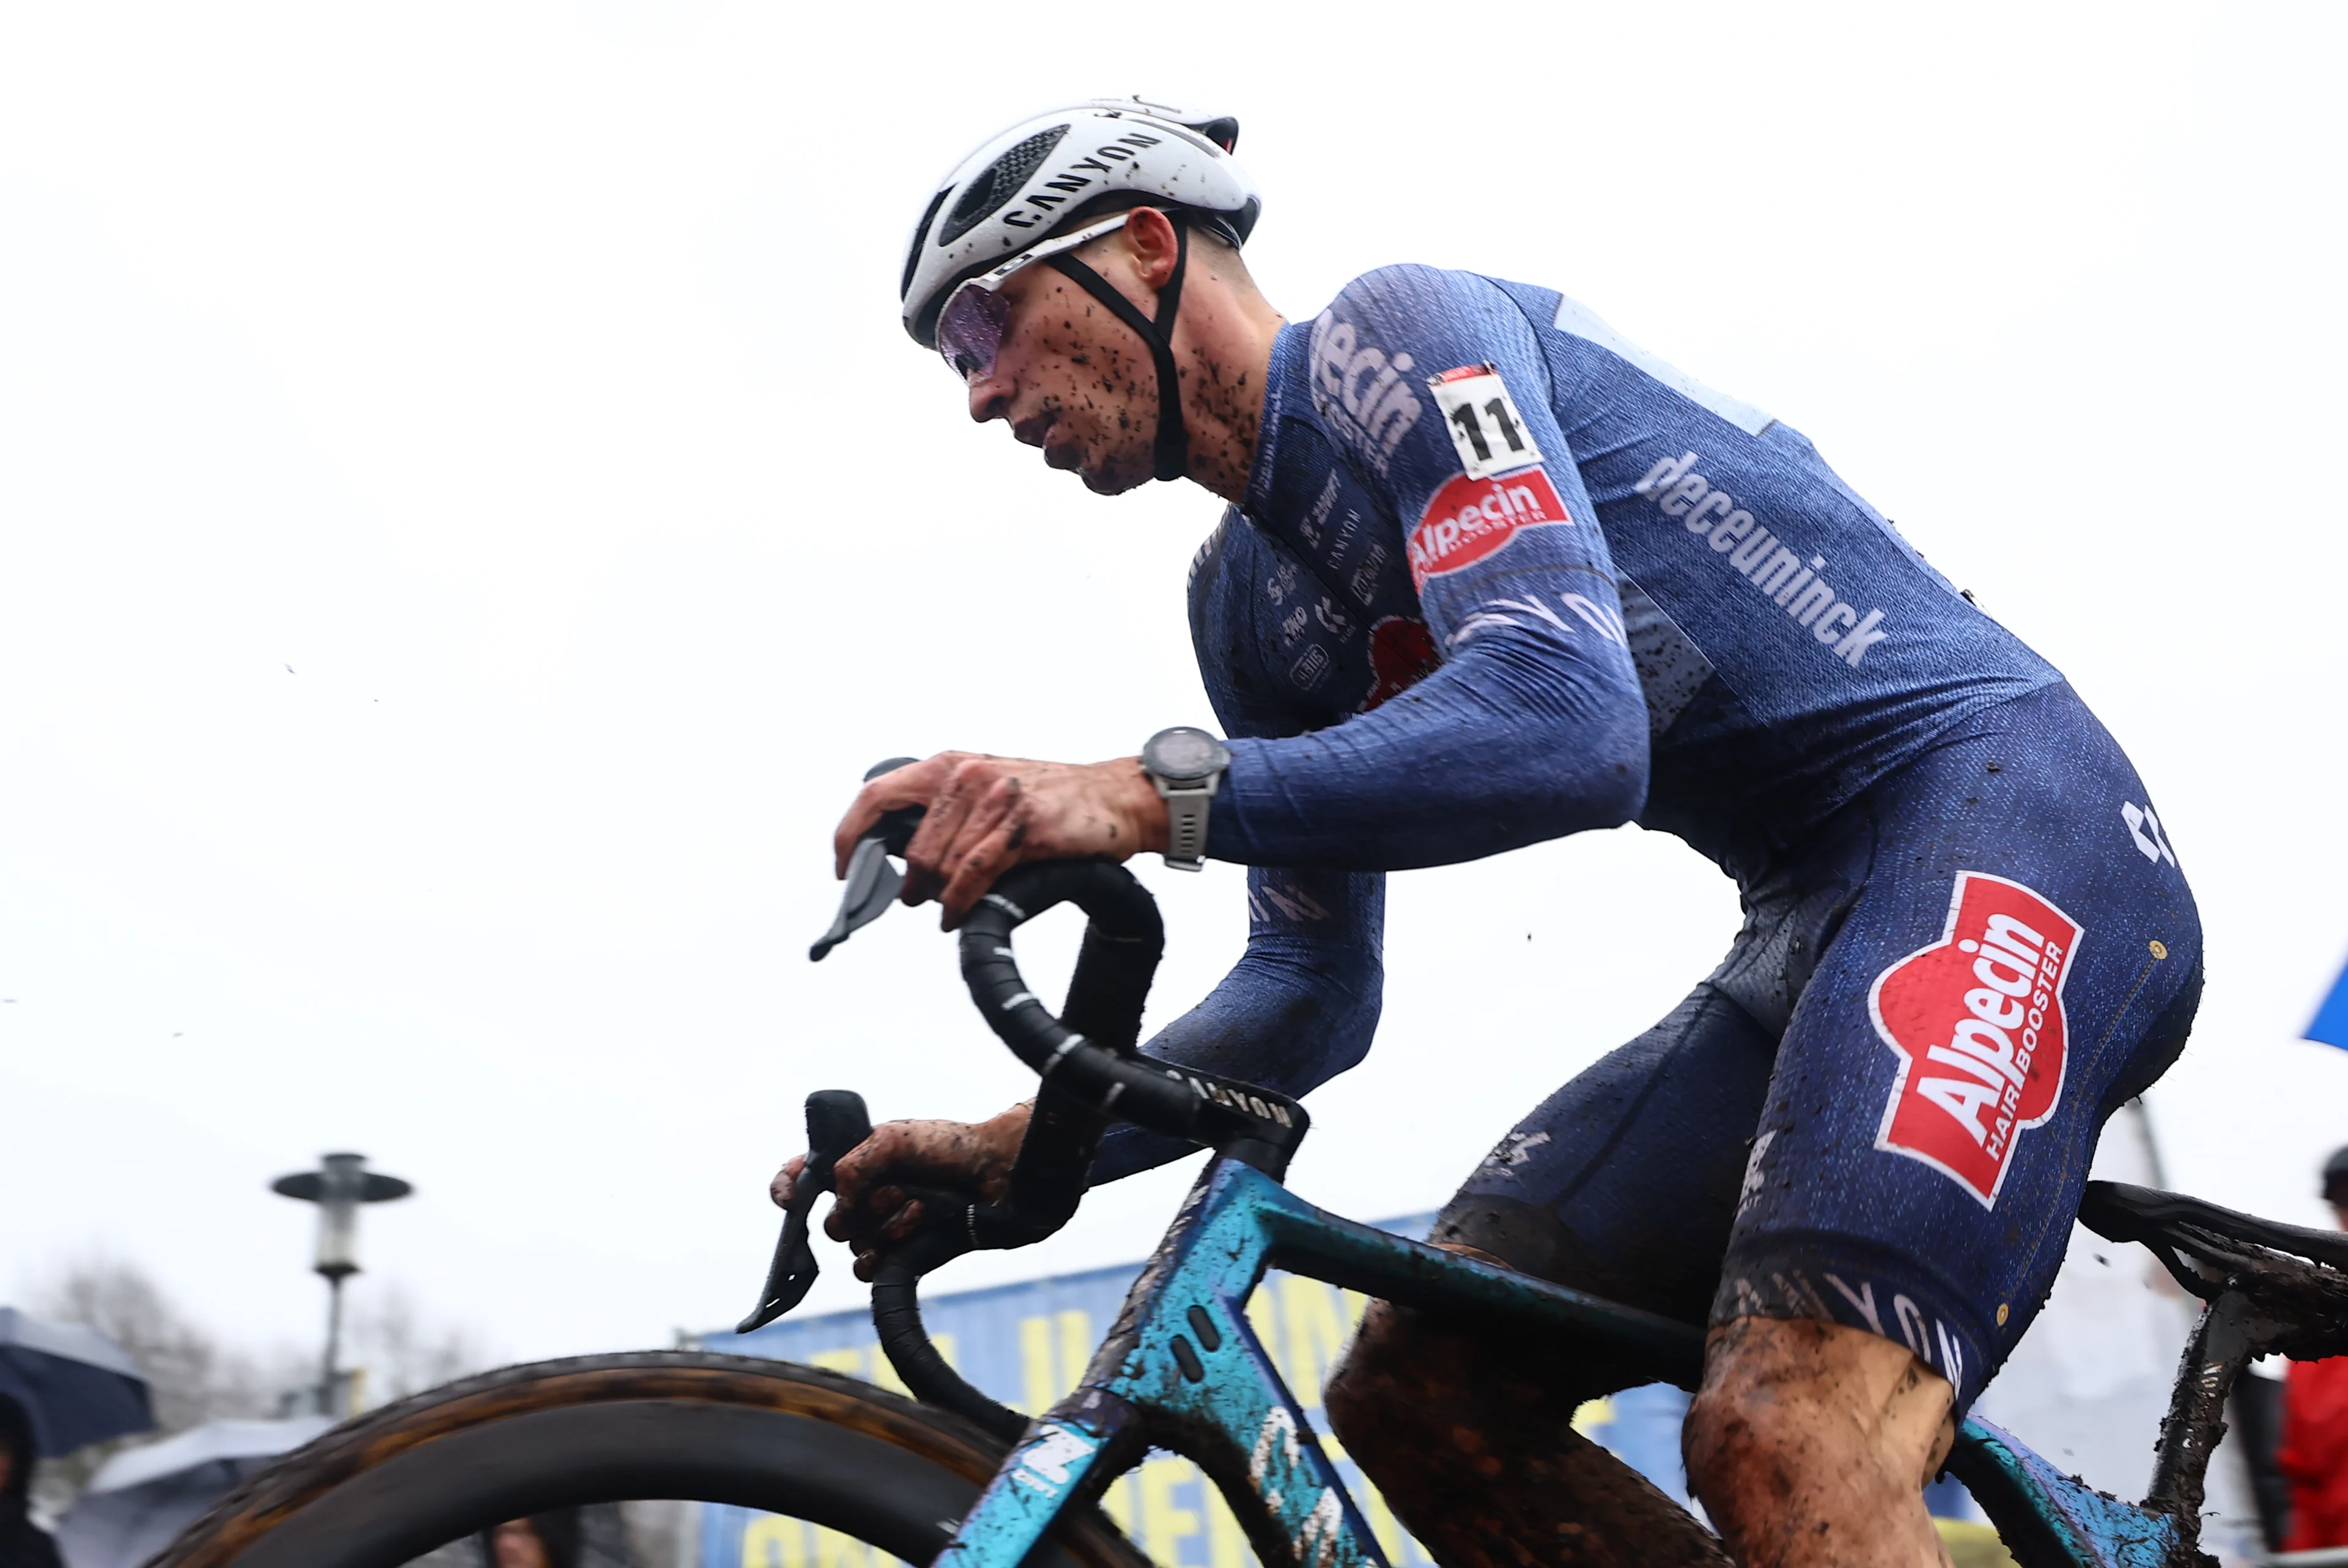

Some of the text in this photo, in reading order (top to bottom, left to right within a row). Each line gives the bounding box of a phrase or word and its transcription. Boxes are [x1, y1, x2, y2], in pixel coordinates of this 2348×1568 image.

[1003, 133, 1162, 229] CANYON
[1450, 397, 1526, 462] 11
[1326, 509, 1361, 570] CANYON
[1408, 483, 1541, 570] Alpecin
[1633, 449, 1887, 668] deceuninck
[1916, 913, 2045, 1147] Alpecin
[1985, 940, 2064, 1161] HAIR BOOSTER
